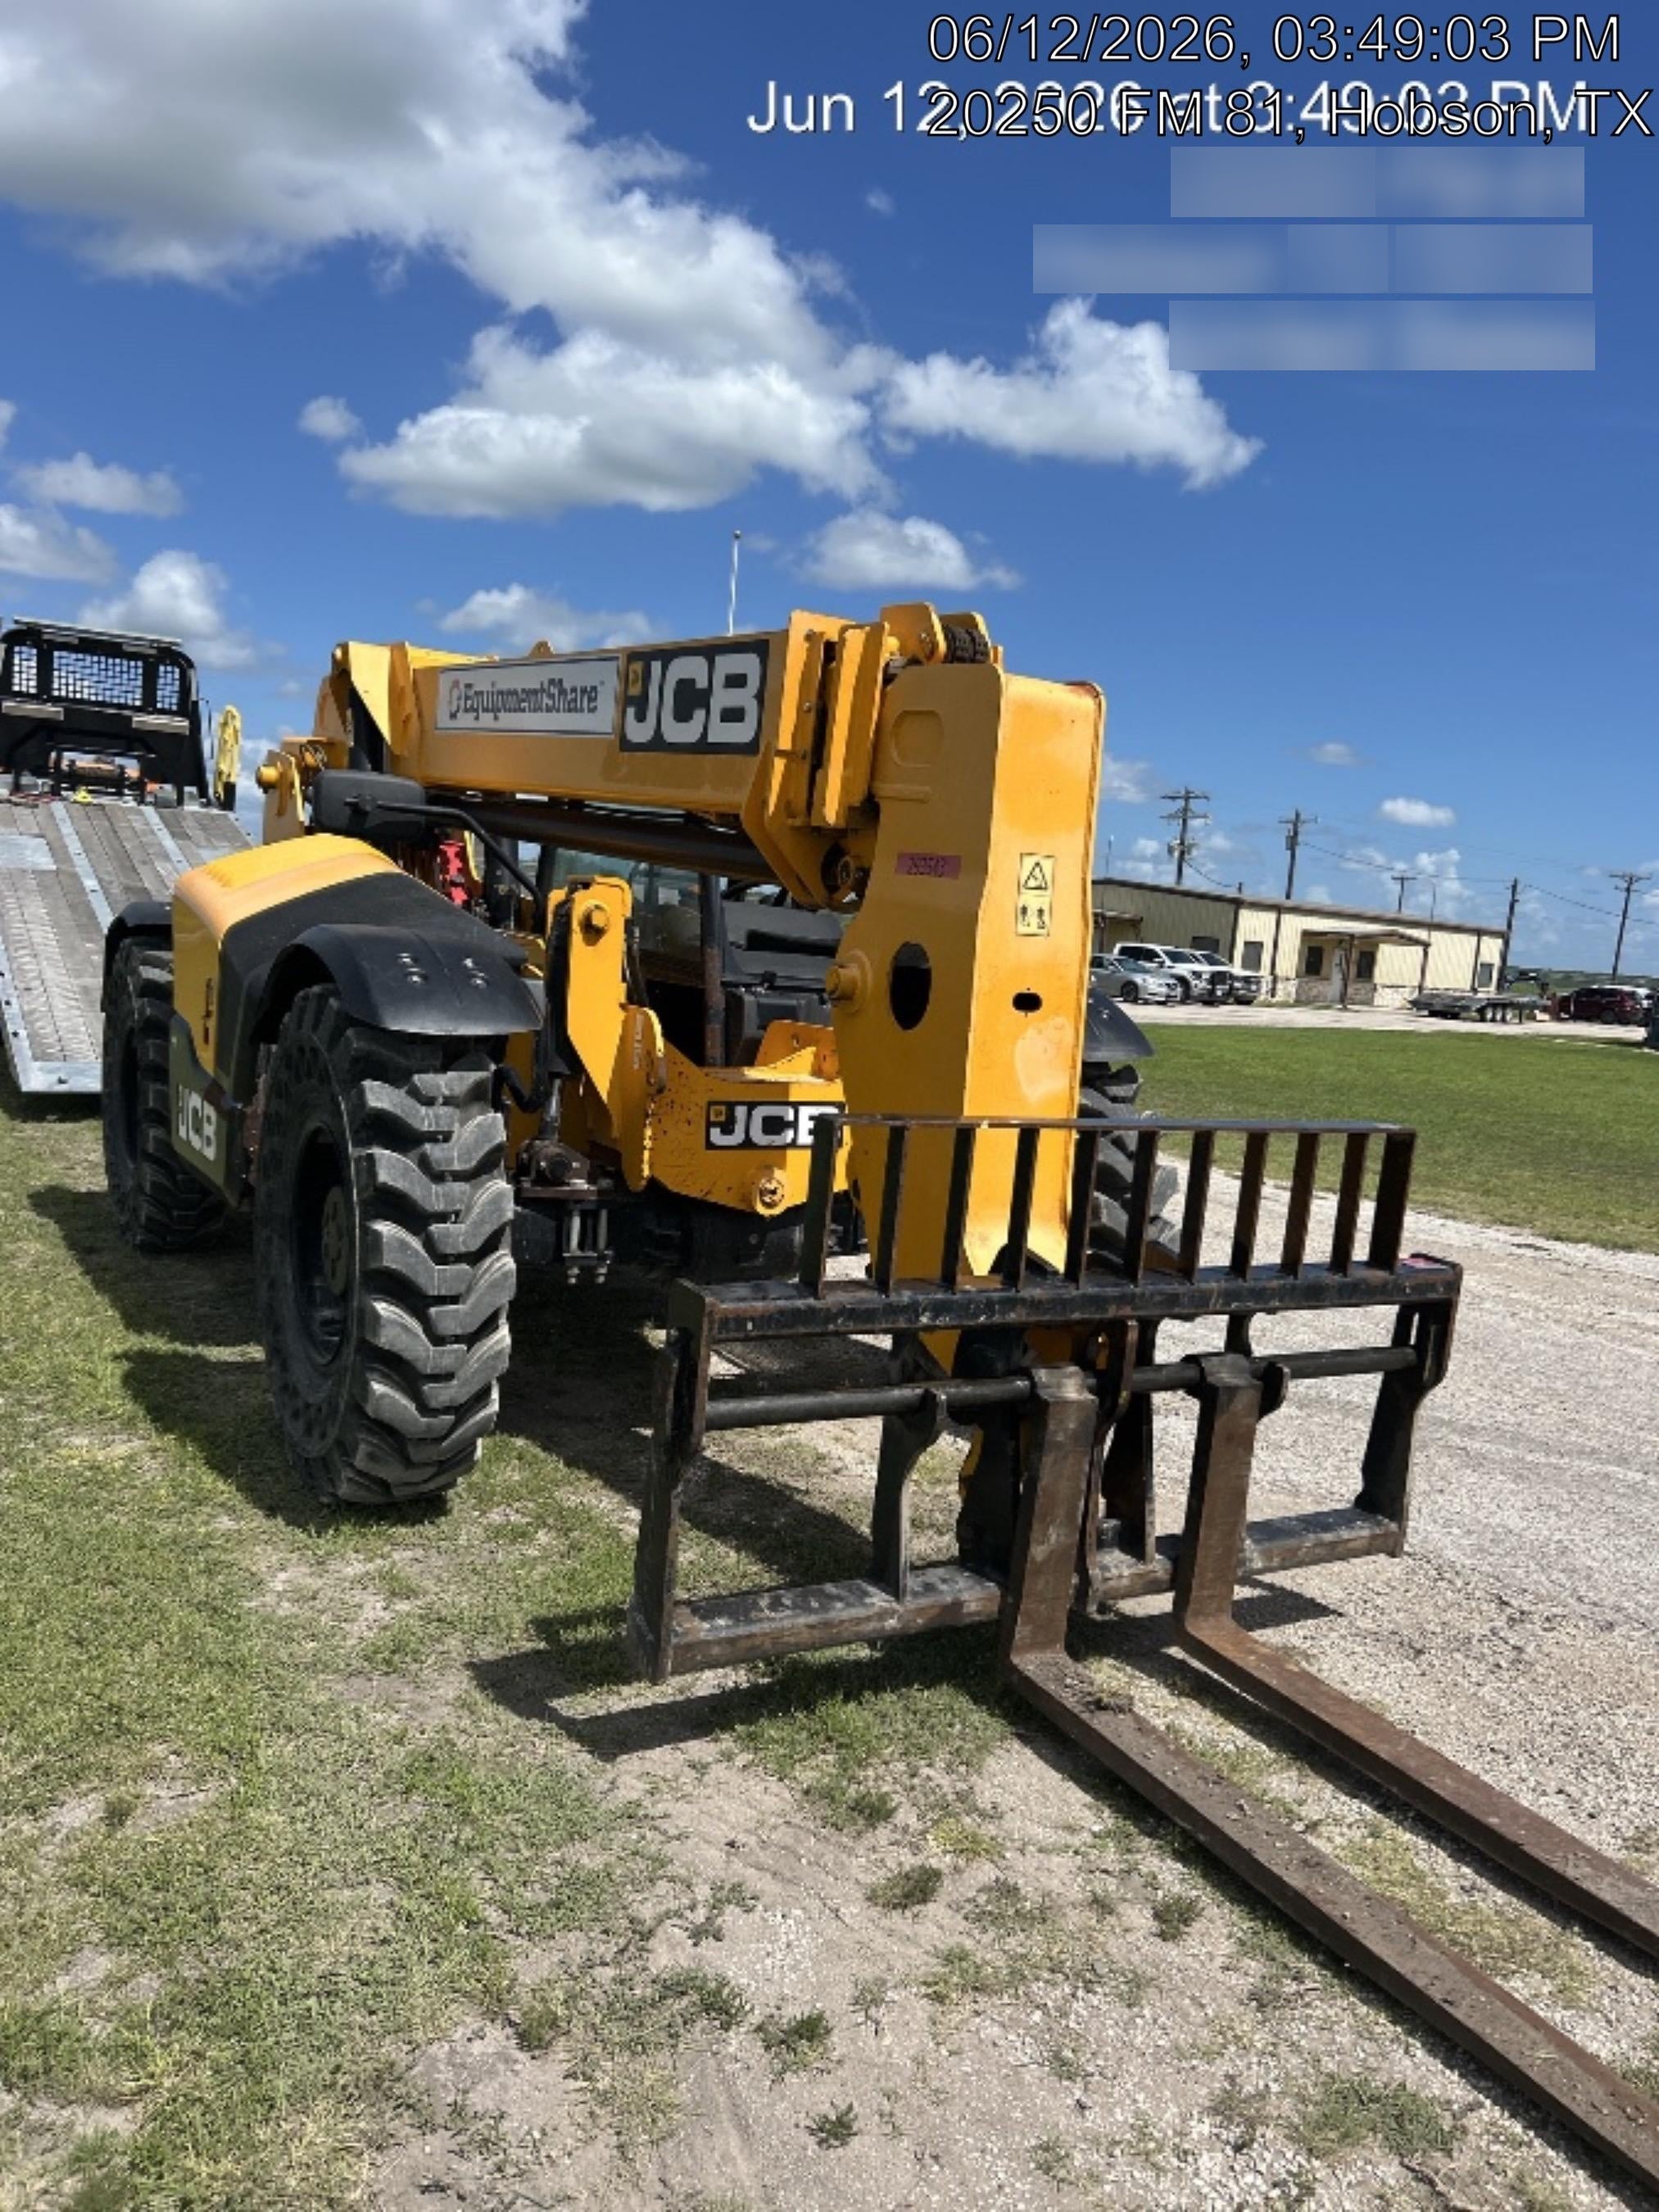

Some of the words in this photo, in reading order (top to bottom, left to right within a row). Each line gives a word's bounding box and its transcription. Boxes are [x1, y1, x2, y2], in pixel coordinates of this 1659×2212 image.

[462, 678, 599, 721] EquipmentShare
[626, 653, 763, 744] JCB
[178, 1082, 217, 1161] JCB
